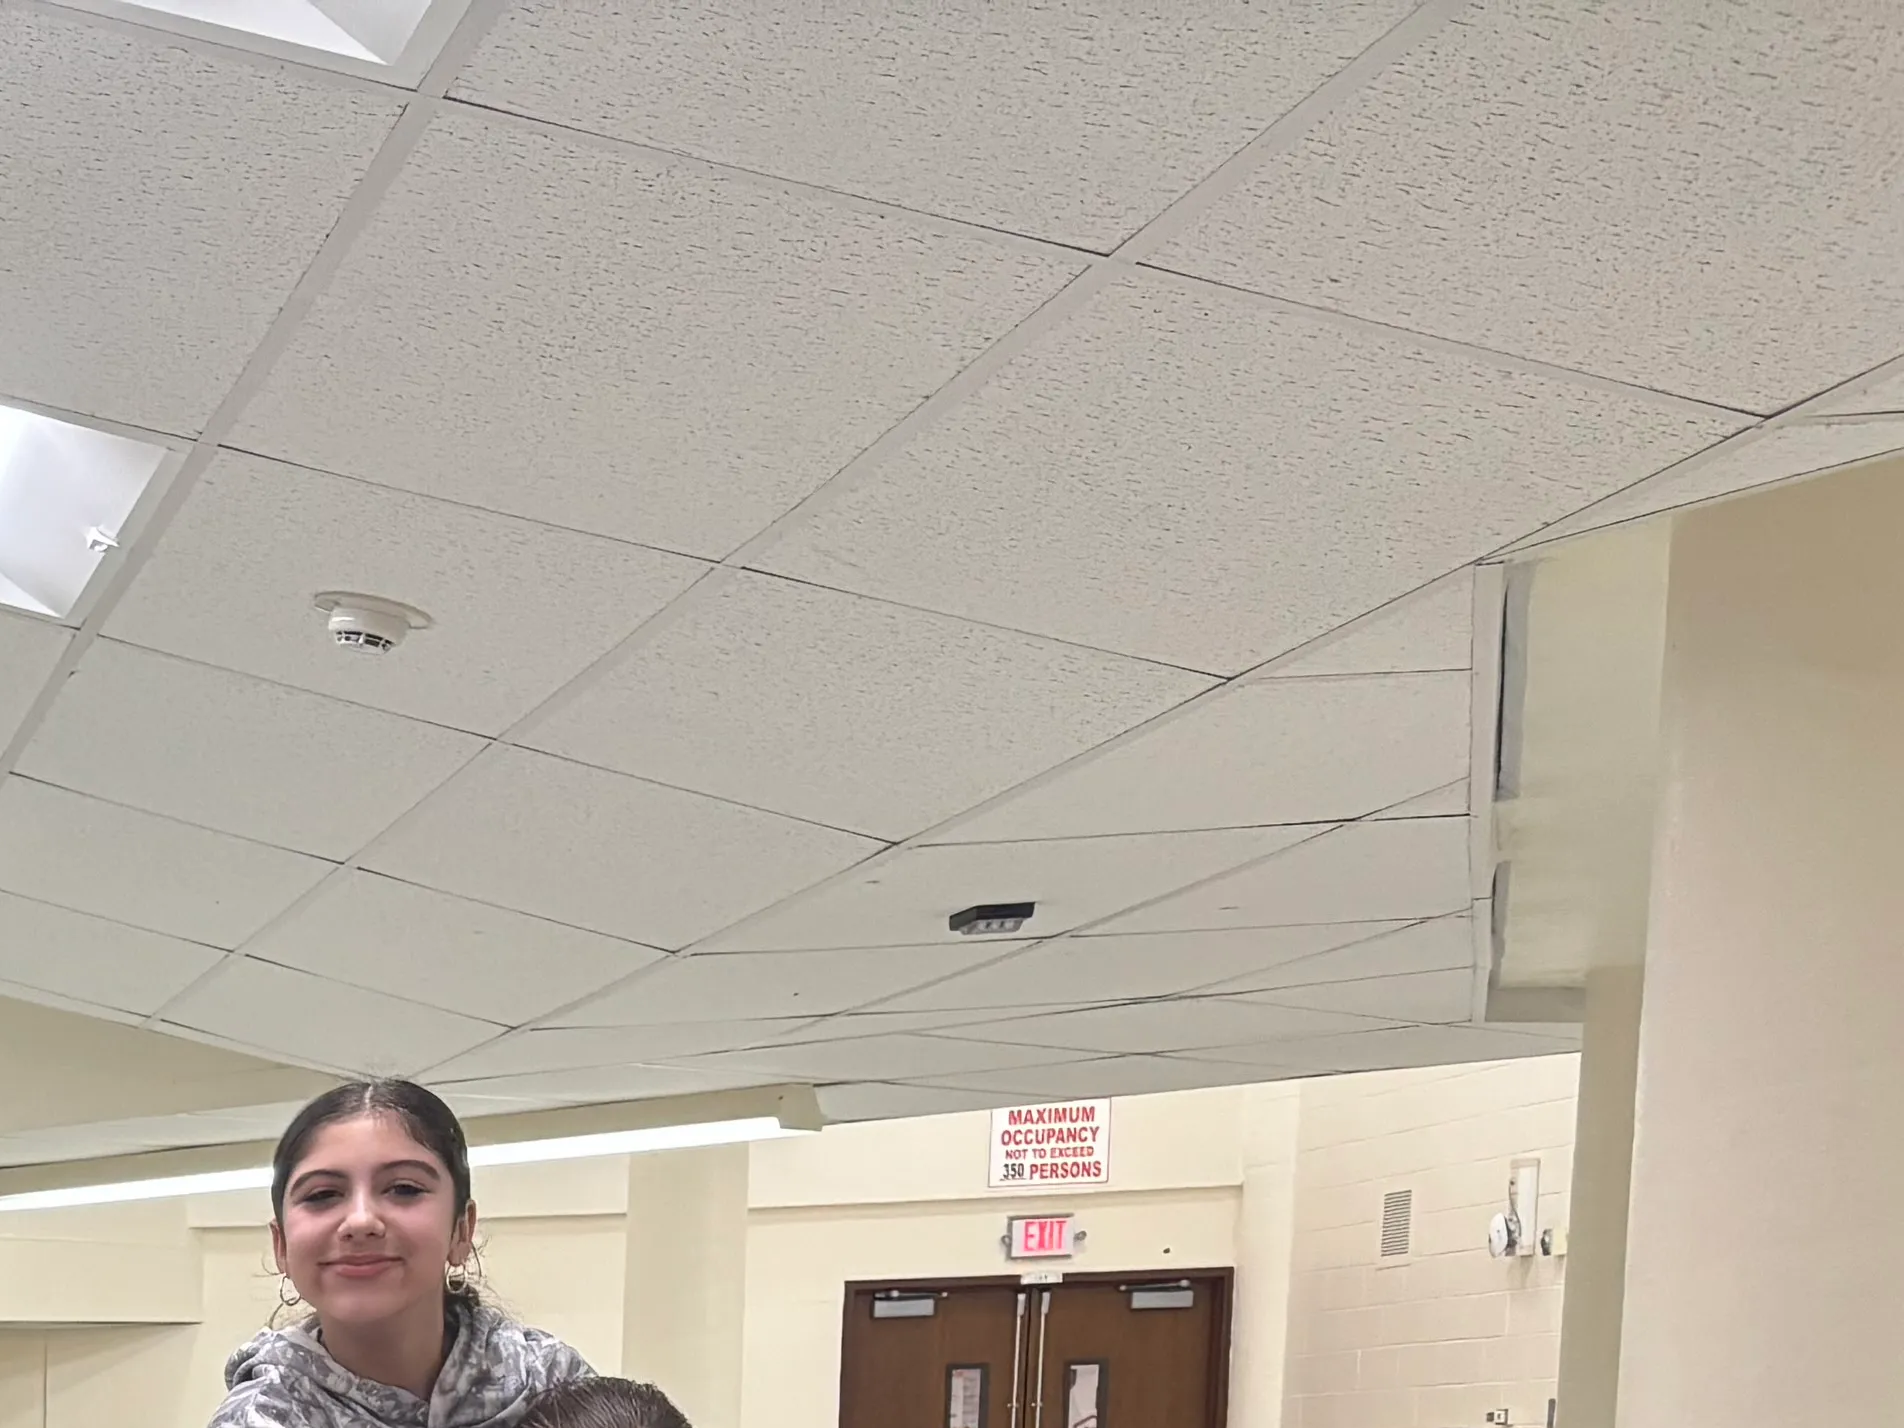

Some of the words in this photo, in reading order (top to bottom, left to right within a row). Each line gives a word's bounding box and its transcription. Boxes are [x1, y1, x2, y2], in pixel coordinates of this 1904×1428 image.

[1008, 1106, 1096, 1126] MAXIMUM
[1001, 1126, 1100, 1146] OCCUPANCY
[1005, 1149, 1028, 1160] NOT
[1032, 1148, 1047, 1159] TO
[1050, 1146, 1094, 1159] EXCEED
[1003, 1163, 1025, 1180] 350
[1029, 1160, 1102, 1180] PERSONS
[1023, 1220, 1067, 1252] EXIT
